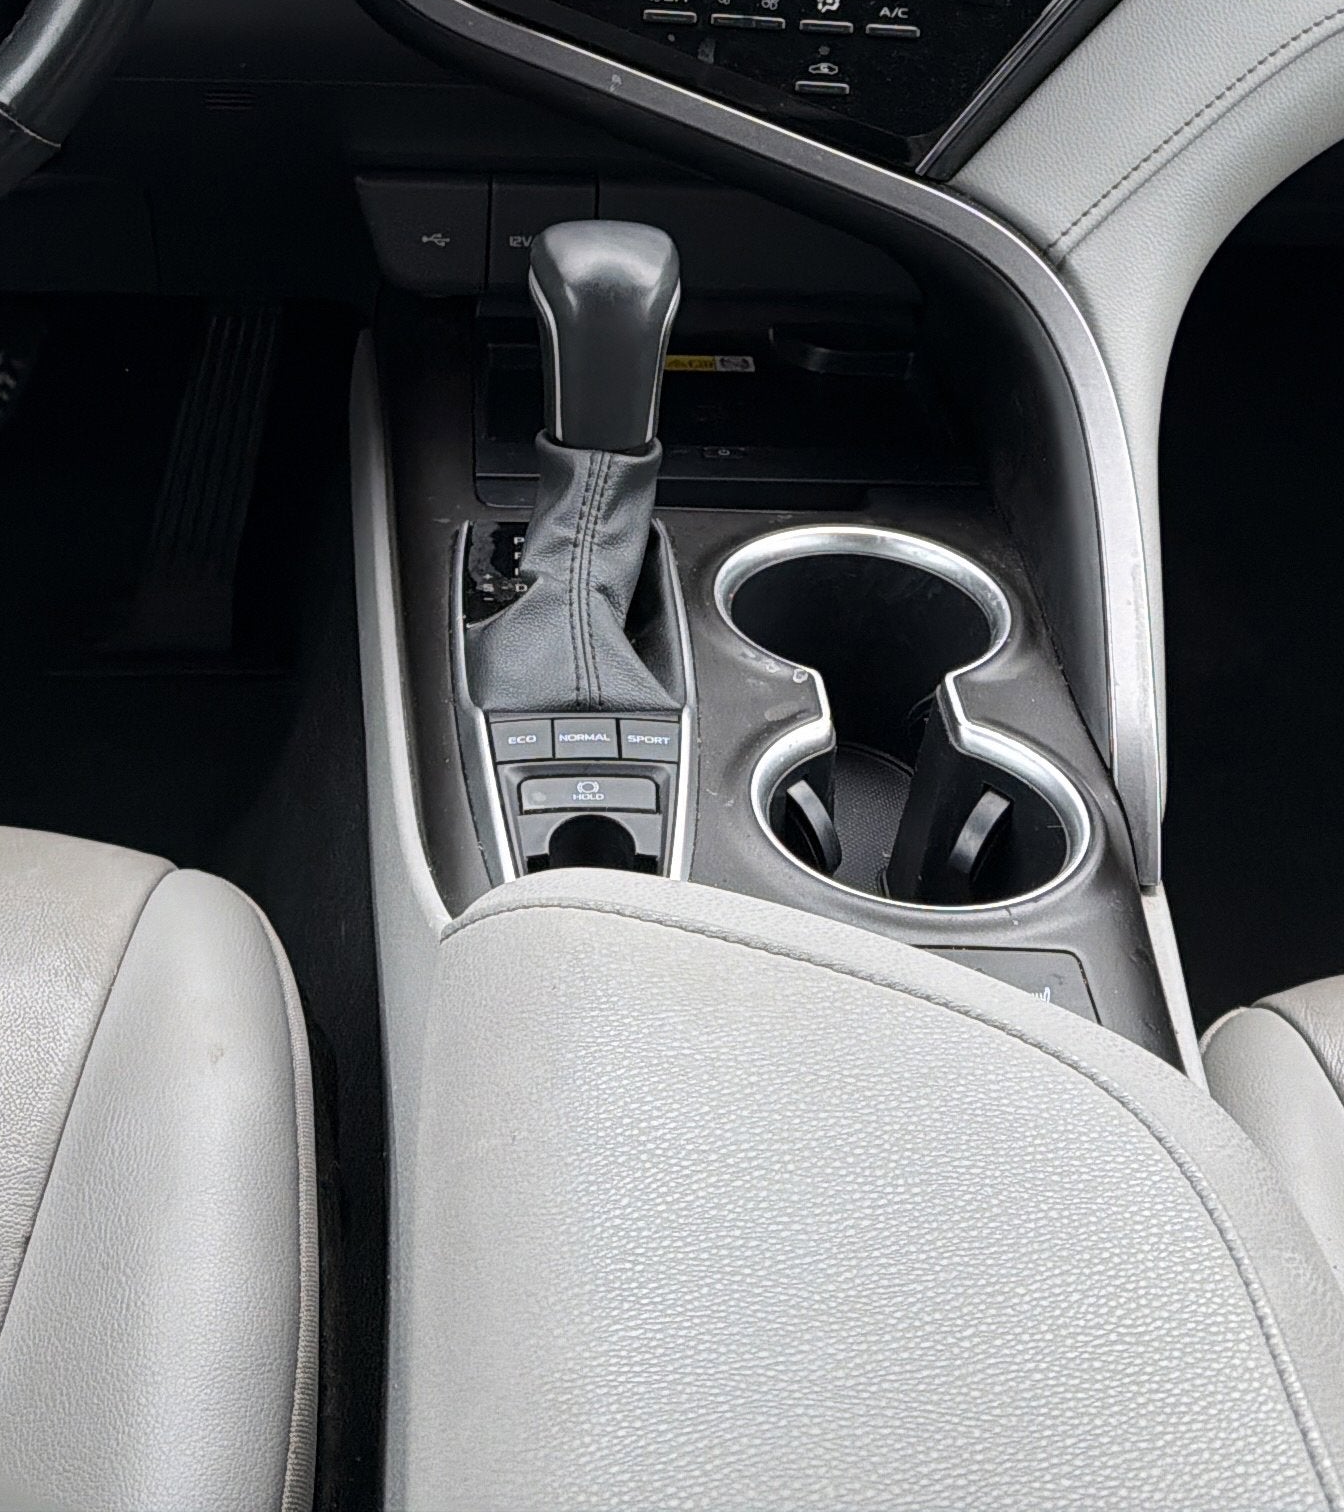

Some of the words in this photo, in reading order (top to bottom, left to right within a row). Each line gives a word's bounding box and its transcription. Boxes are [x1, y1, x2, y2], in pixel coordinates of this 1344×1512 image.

[879, 7, 909, 19] A/C
[509, 235, 532, 248] 12V
[508, 734, 537, 745] ECO
[559, 733, 611, 743] NORMAL
[627, 734, 670, 745] SPORT
[572, 792, 605, 801] HOLD
